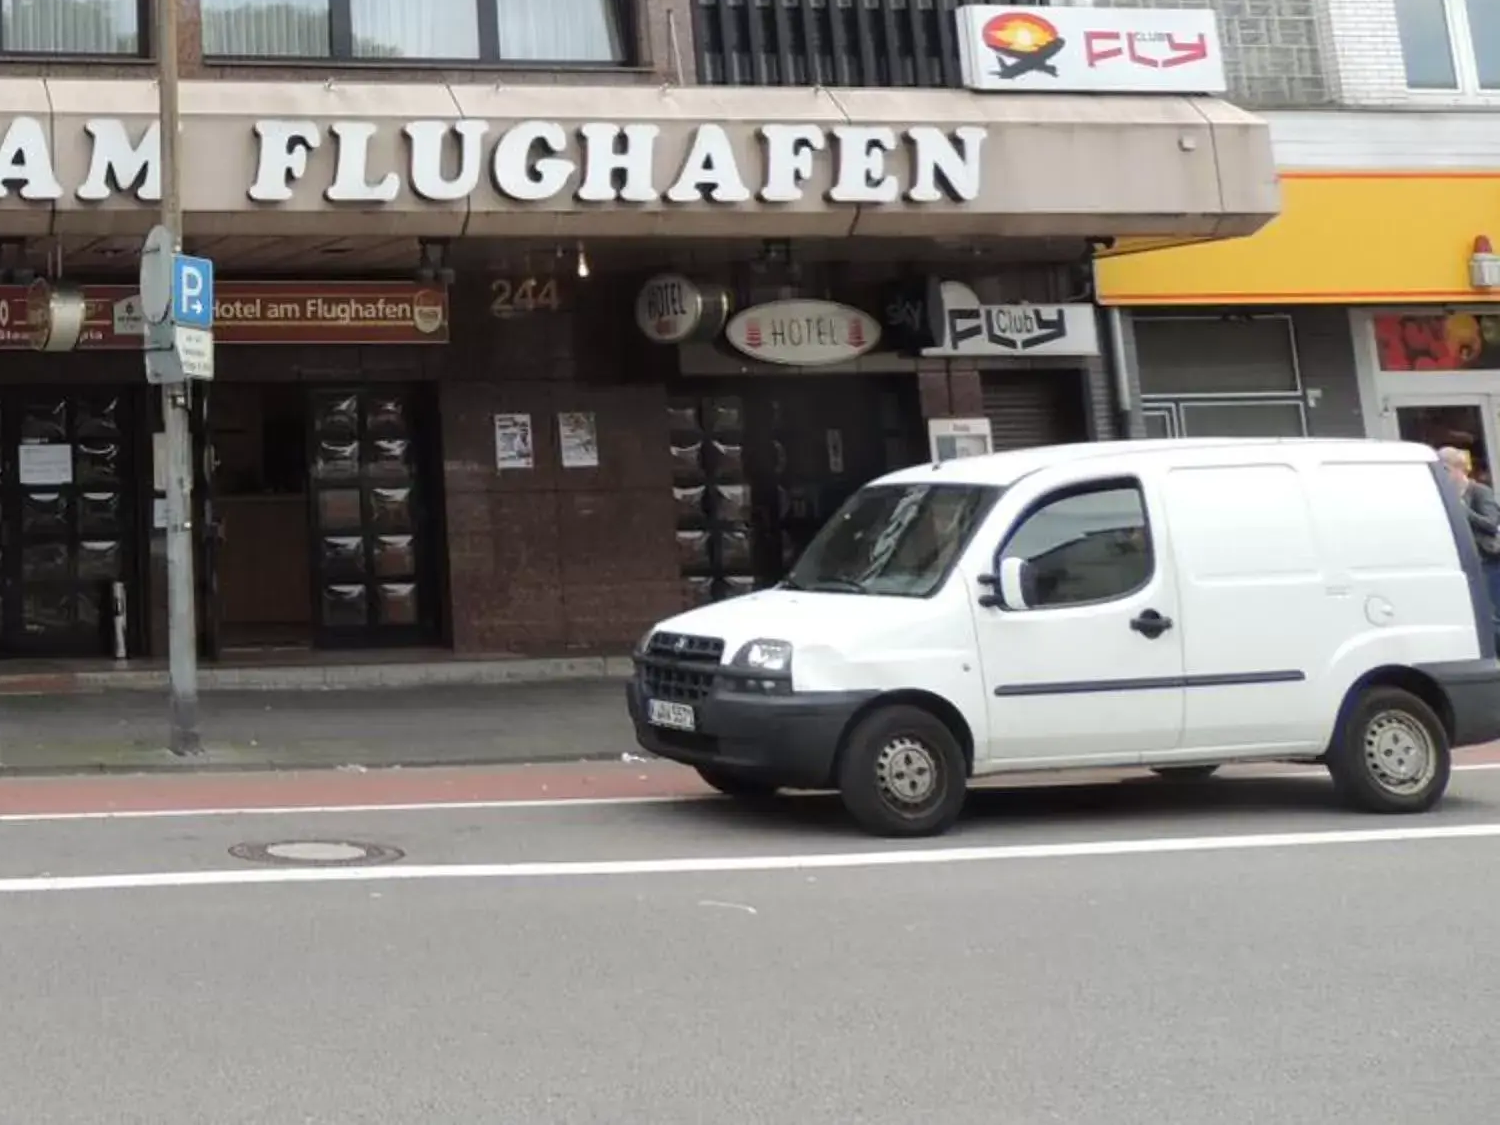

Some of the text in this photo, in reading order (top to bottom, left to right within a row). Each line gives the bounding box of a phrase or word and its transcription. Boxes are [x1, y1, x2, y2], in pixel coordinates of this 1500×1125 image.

[1084, 30, 1207, 68] FLY
[246, 118, 989, 203] FLUGHAFEN
[181, 266, 203, 314] P
[491, 279, 559, 313] 244
[648, 281, 687, 319] HOTEL
[267, 302, 301, 319] am
[306, 298, 412, 324] Flughafen
[948, 308, 1066, 350] FLY
[995, 309, 1034, 334] Club
[771, 317, 841, 347] HOTEL
